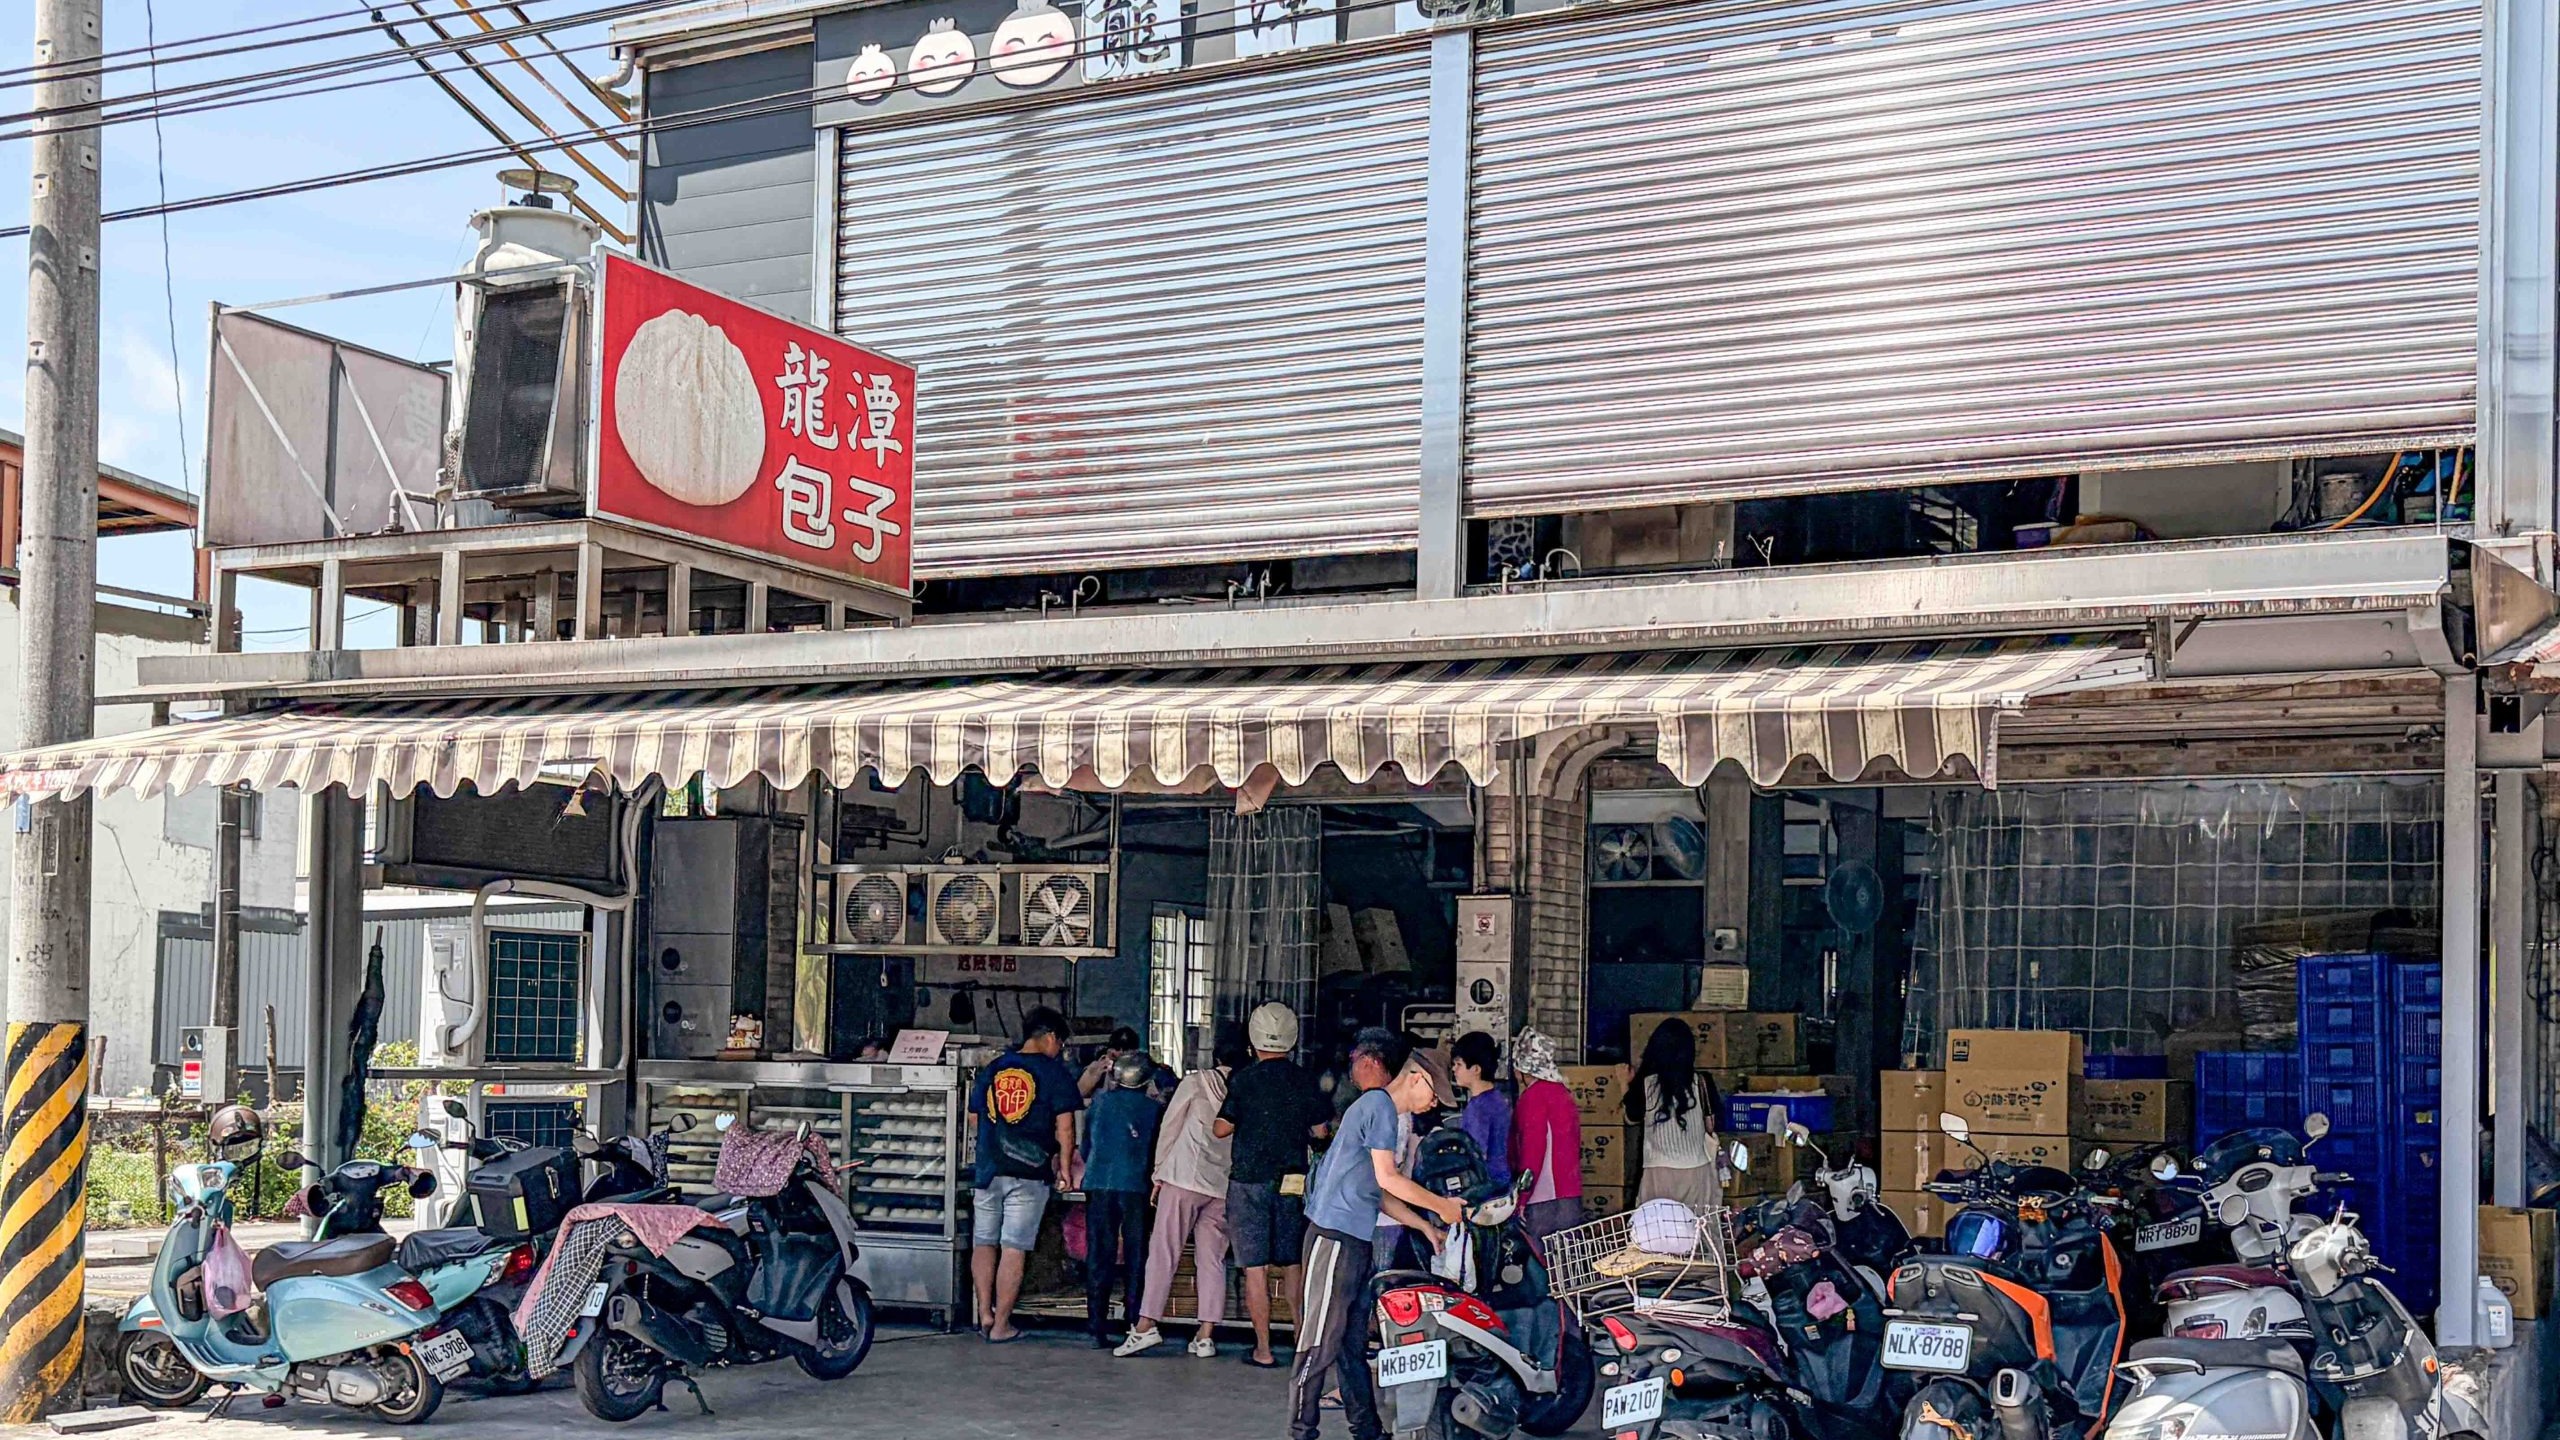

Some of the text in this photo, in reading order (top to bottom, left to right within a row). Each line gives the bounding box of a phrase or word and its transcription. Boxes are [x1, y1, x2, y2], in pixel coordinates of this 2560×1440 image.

[775, 340, 903, 469] 龍潭
[775, 453, 901, 563] 包子
[1381, 1349, 1441, 1377] MKB-8921
[1887, 1333, 1964, 1358] NLK-8788
